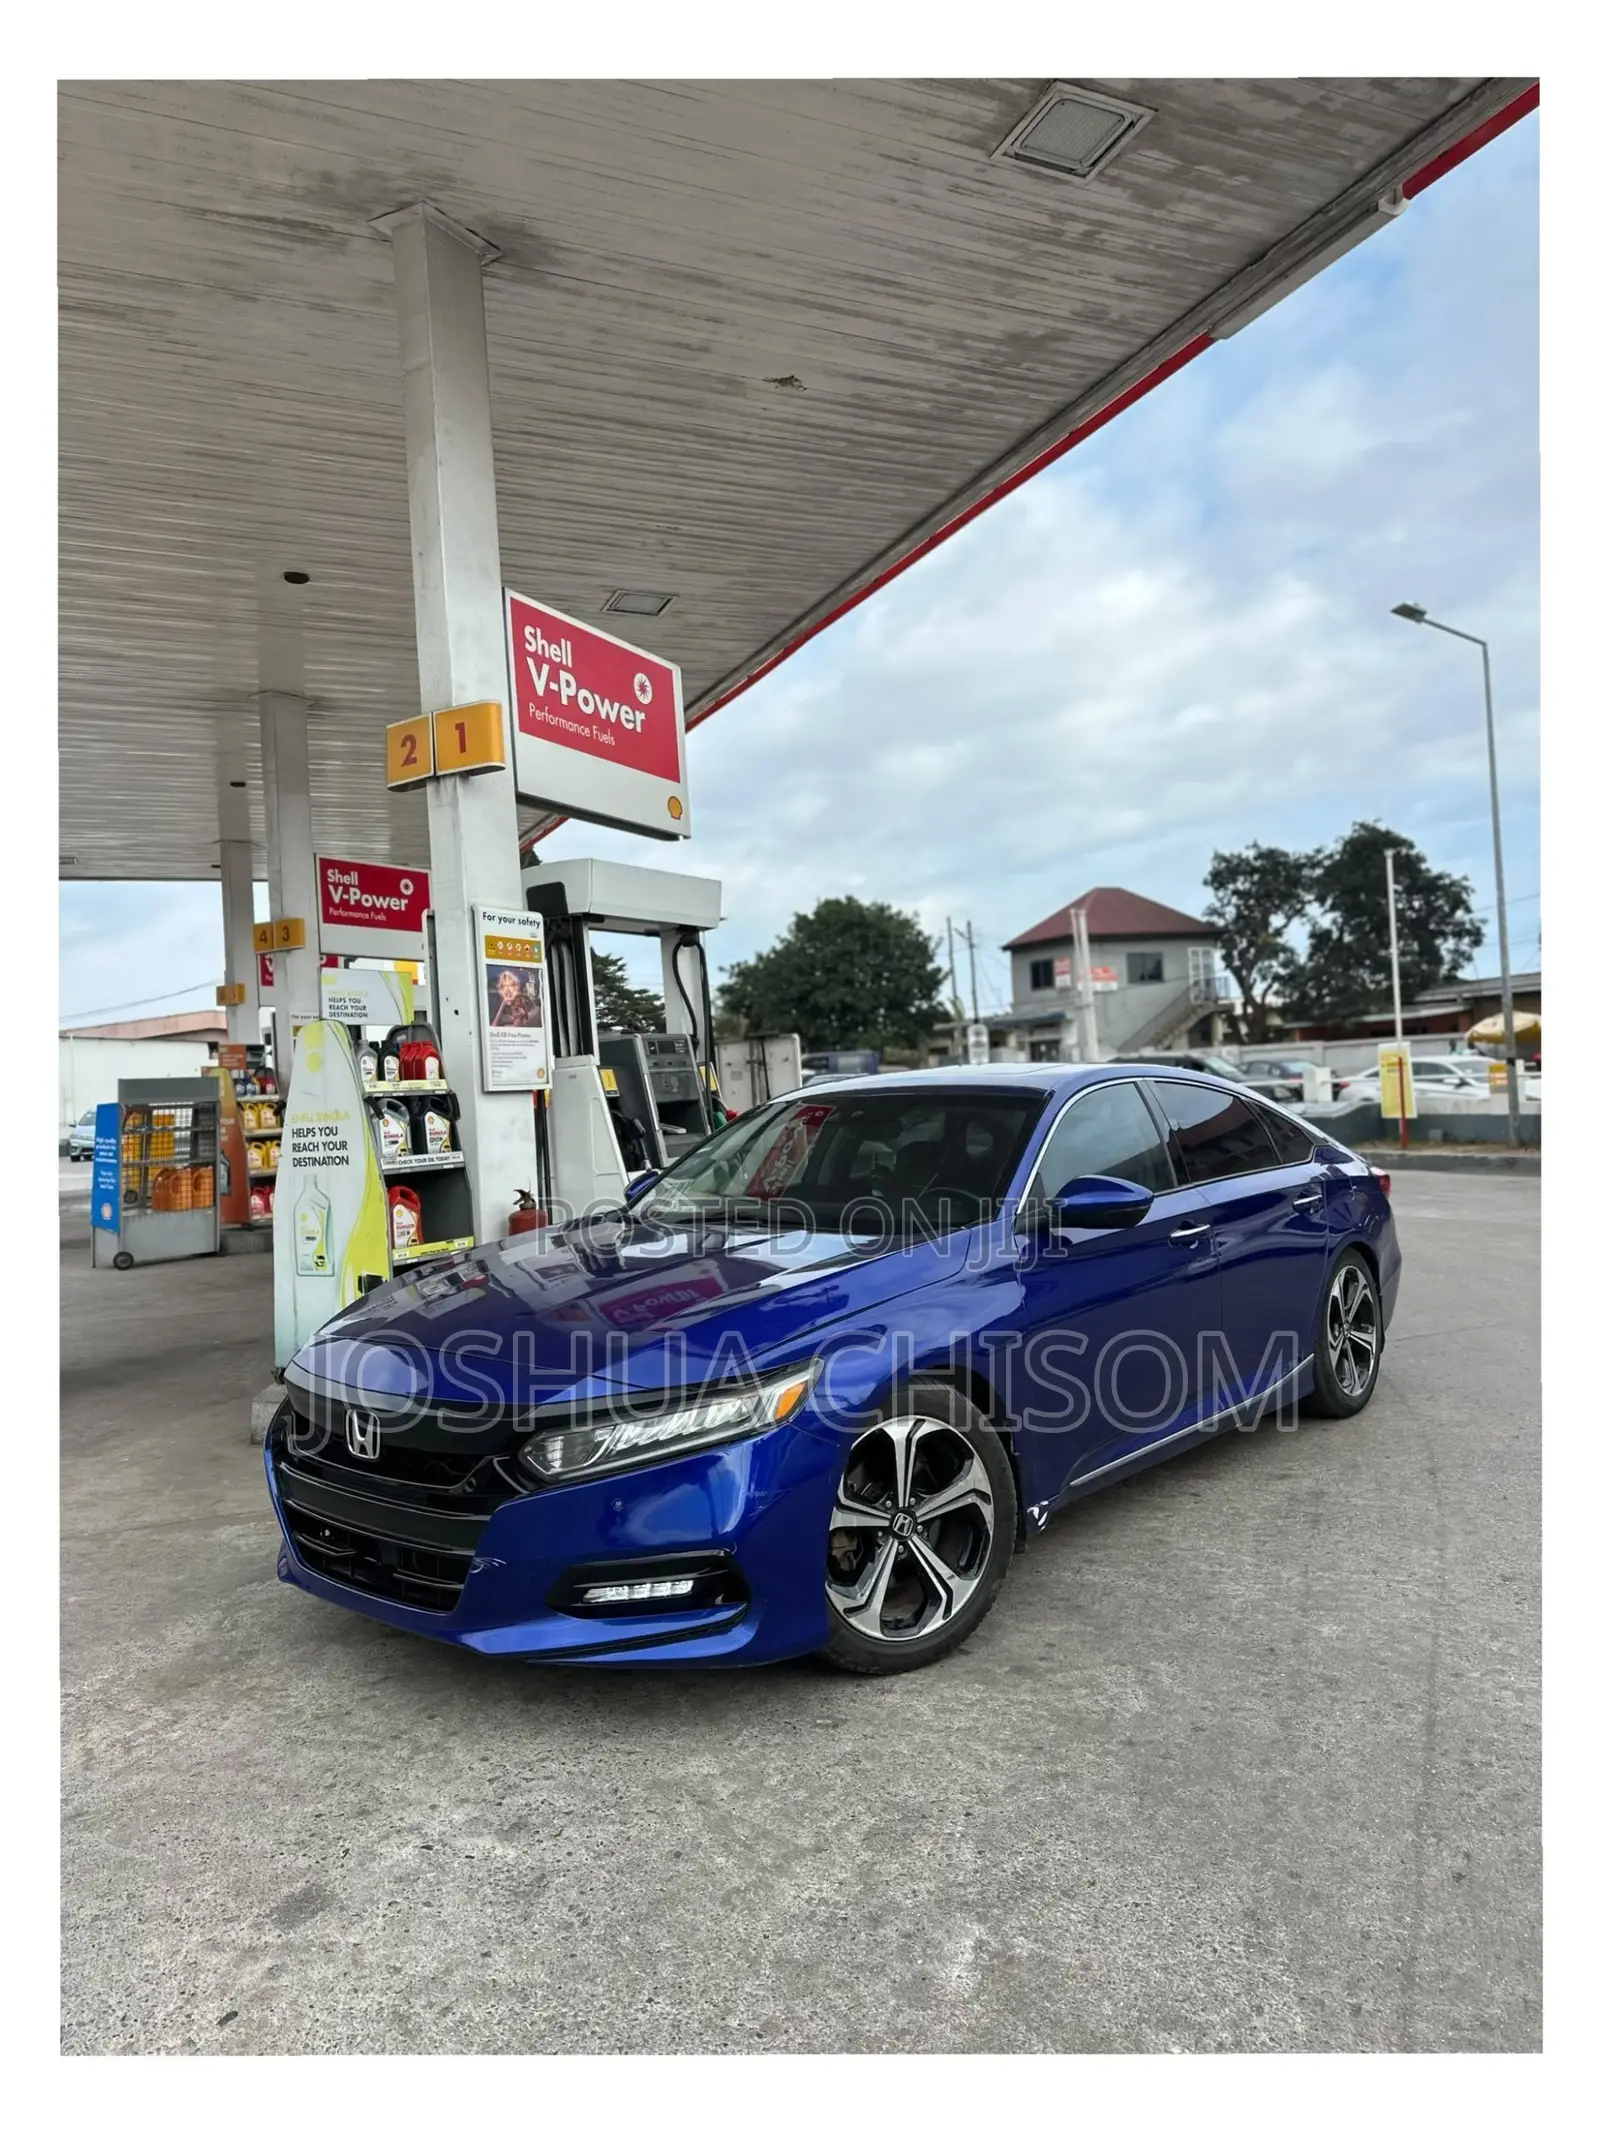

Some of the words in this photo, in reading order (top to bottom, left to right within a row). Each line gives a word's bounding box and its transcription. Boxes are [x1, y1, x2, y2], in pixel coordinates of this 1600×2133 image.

[524, 625, 573, 668] Shell
[526, 656, 646, 733] V-Power
[529, 702, 591, 738] Performance
[592, 724, 616, 747] Fuels
[455, 722, 467, 754] 1
[401, 733, 418, 768] 2
[327, 868, 359, 886] Shell
[328, 884, 408, 912] V-Power
[328, 907, 370, 920] Performance
[370, 911, 387, 921] Fuels
[482, 911, 496, 921] For
[497, 915, 516, 925] your
[517, 916, 541, 930] safety
[259, 929, 268, 944] 4
[282, 925, 290, 942] 3
[291, 1127, 317, 1139] HELPS
[317, 1125, 339, 1137] YOU
[291, 1142, 320, 1153] REACH
[321, 1140, 349, 1152] YOUR
[292, 1155, 350, 1168] DESTINATION
